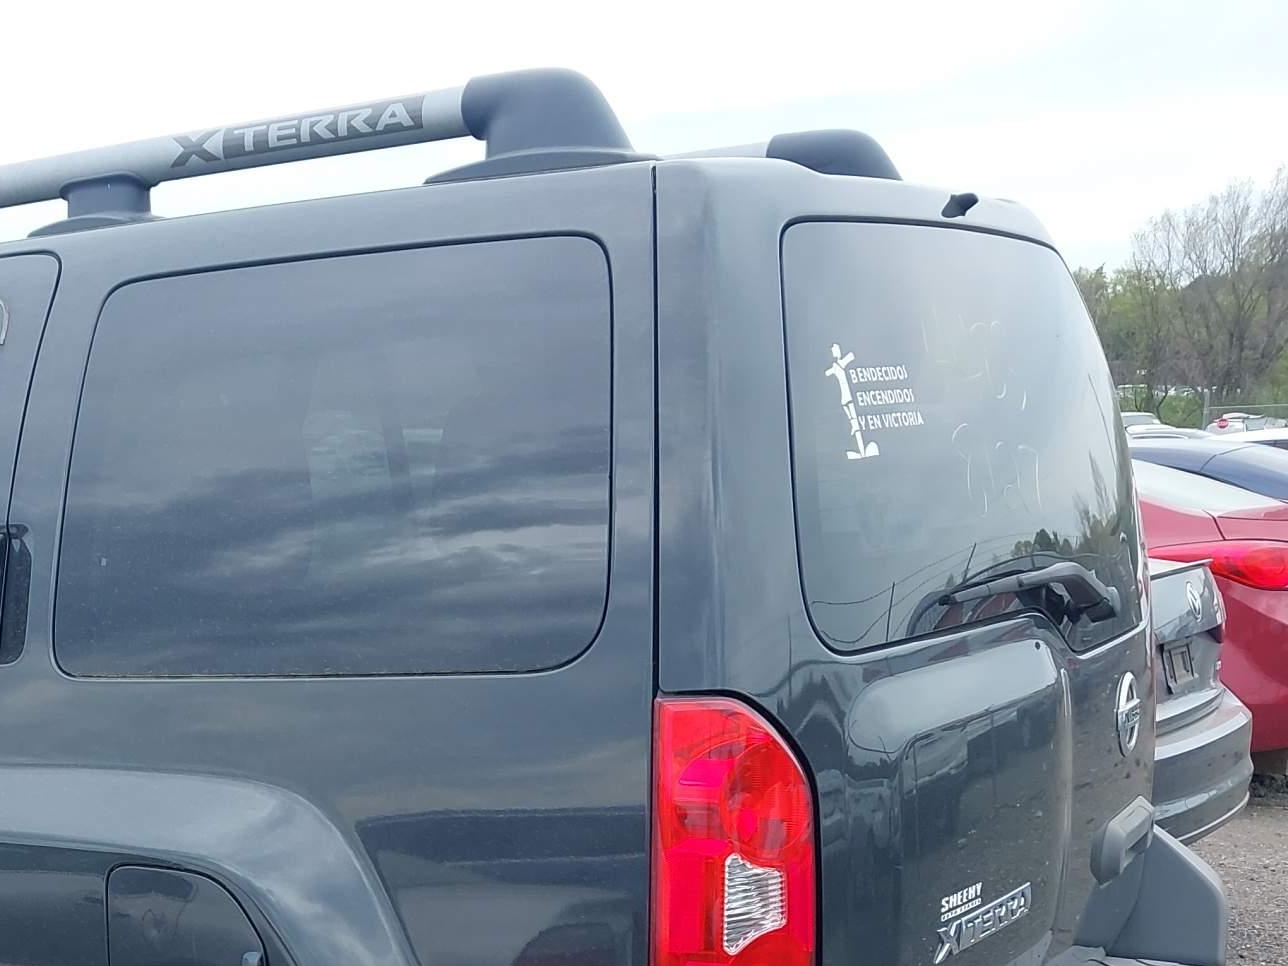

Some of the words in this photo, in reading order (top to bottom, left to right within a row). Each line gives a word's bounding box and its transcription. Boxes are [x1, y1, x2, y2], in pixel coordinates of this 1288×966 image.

[170, 102, 414, 169] XTERRA
[858, 415, 866, 430] Y
[866, 414, 883, 430] EN
[881, 411, 925, 429] VICTORIA
